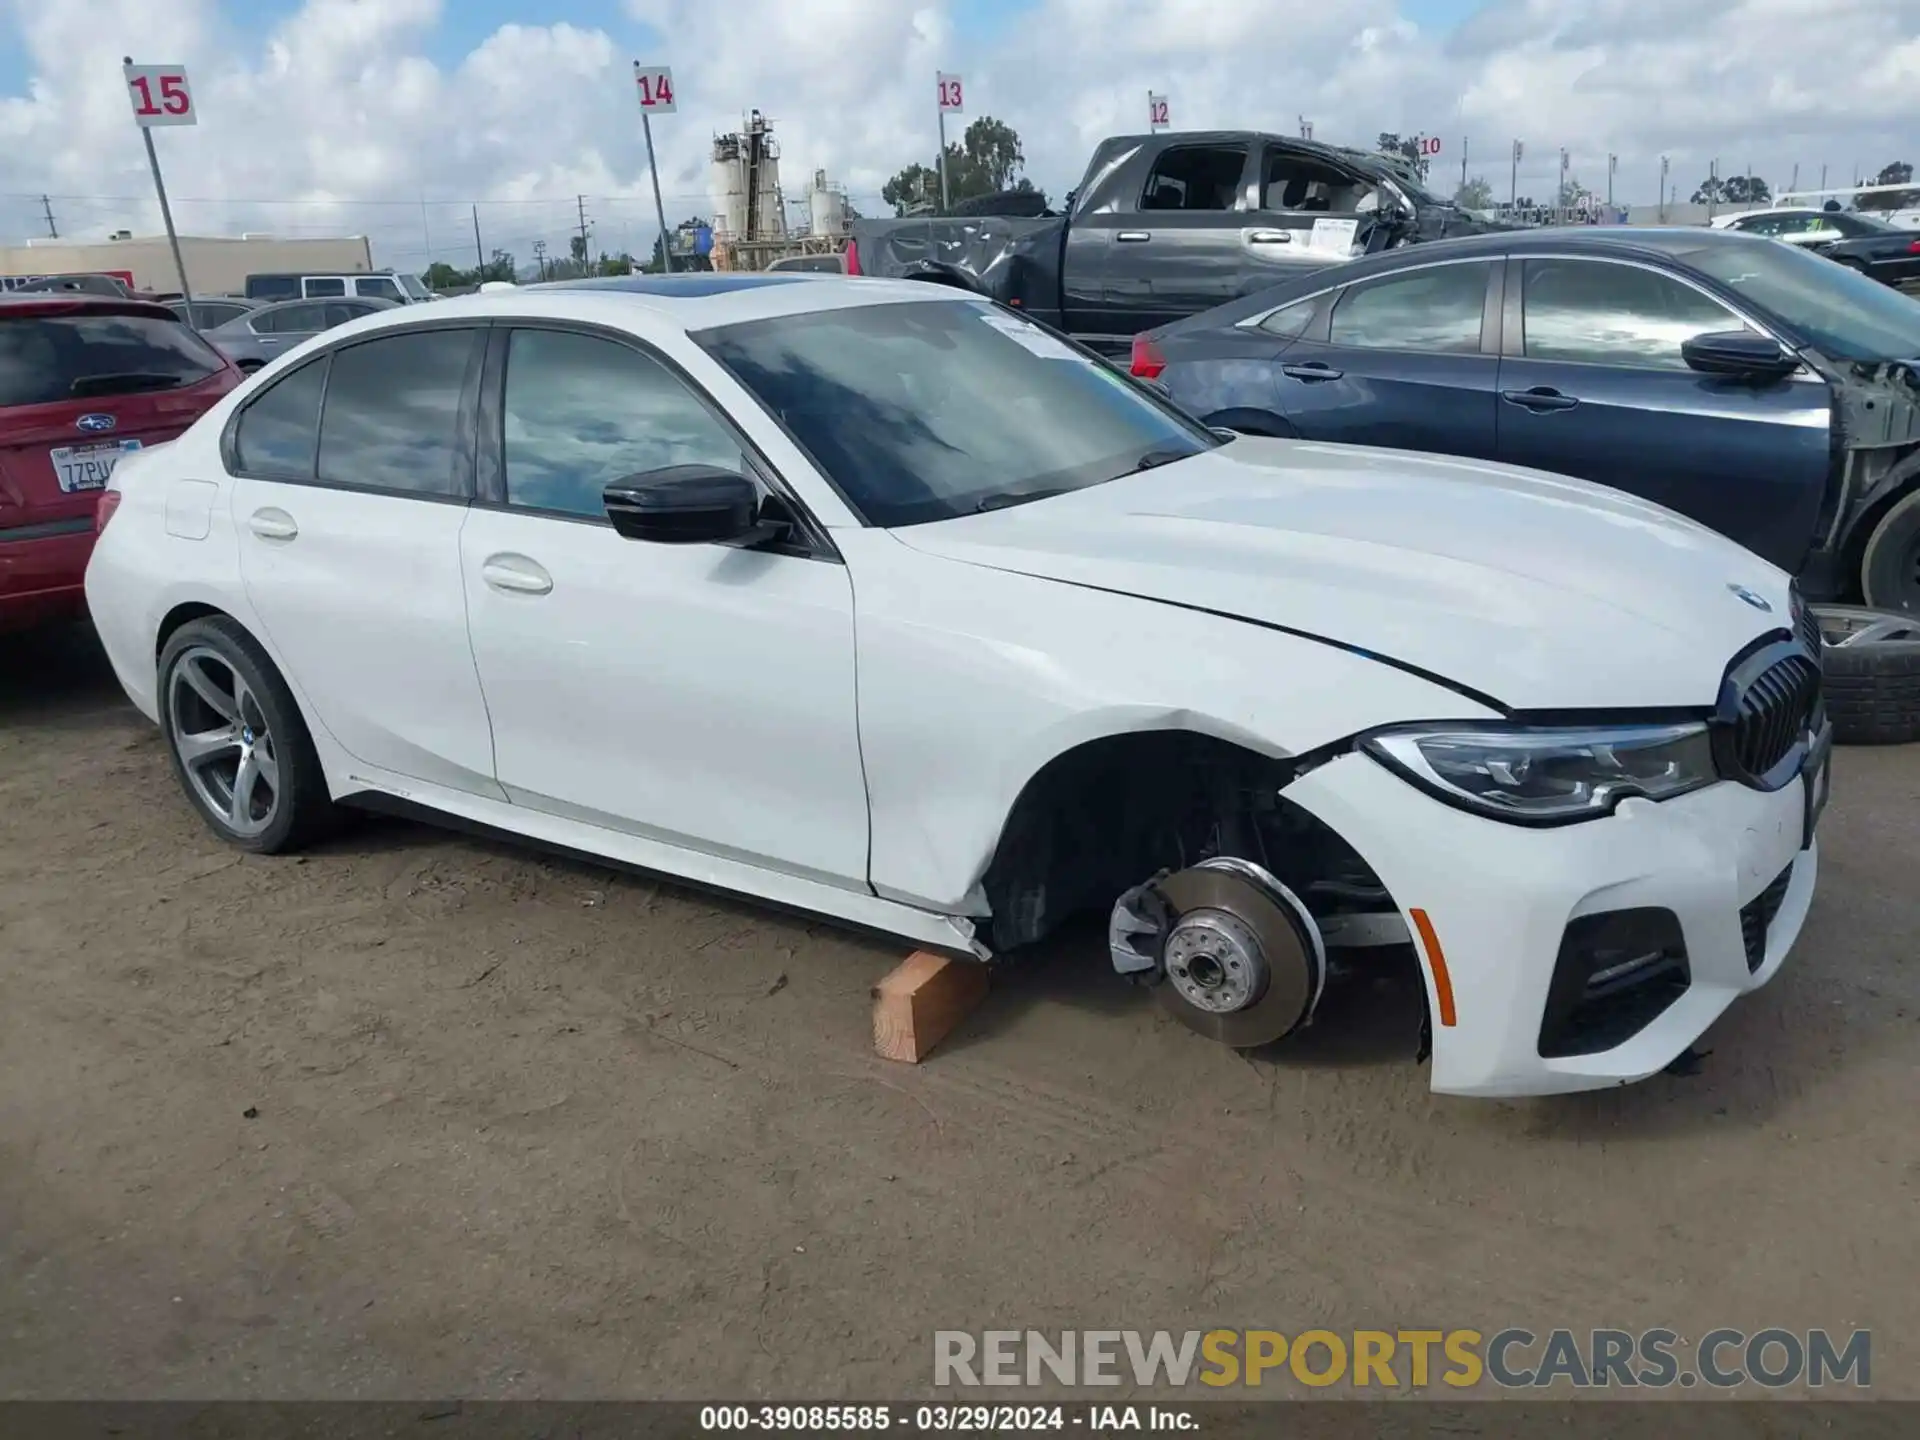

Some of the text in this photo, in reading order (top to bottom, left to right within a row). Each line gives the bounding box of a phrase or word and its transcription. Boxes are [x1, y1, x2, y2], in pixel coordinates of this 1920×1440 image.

[130, 76, 189, 115] 15
[637, 74, 673, 105] 14
[939, 81, 962, 106] 13
[1151, 102, 1169, 123] 12
[1420, 137, 1441, 155] 10
